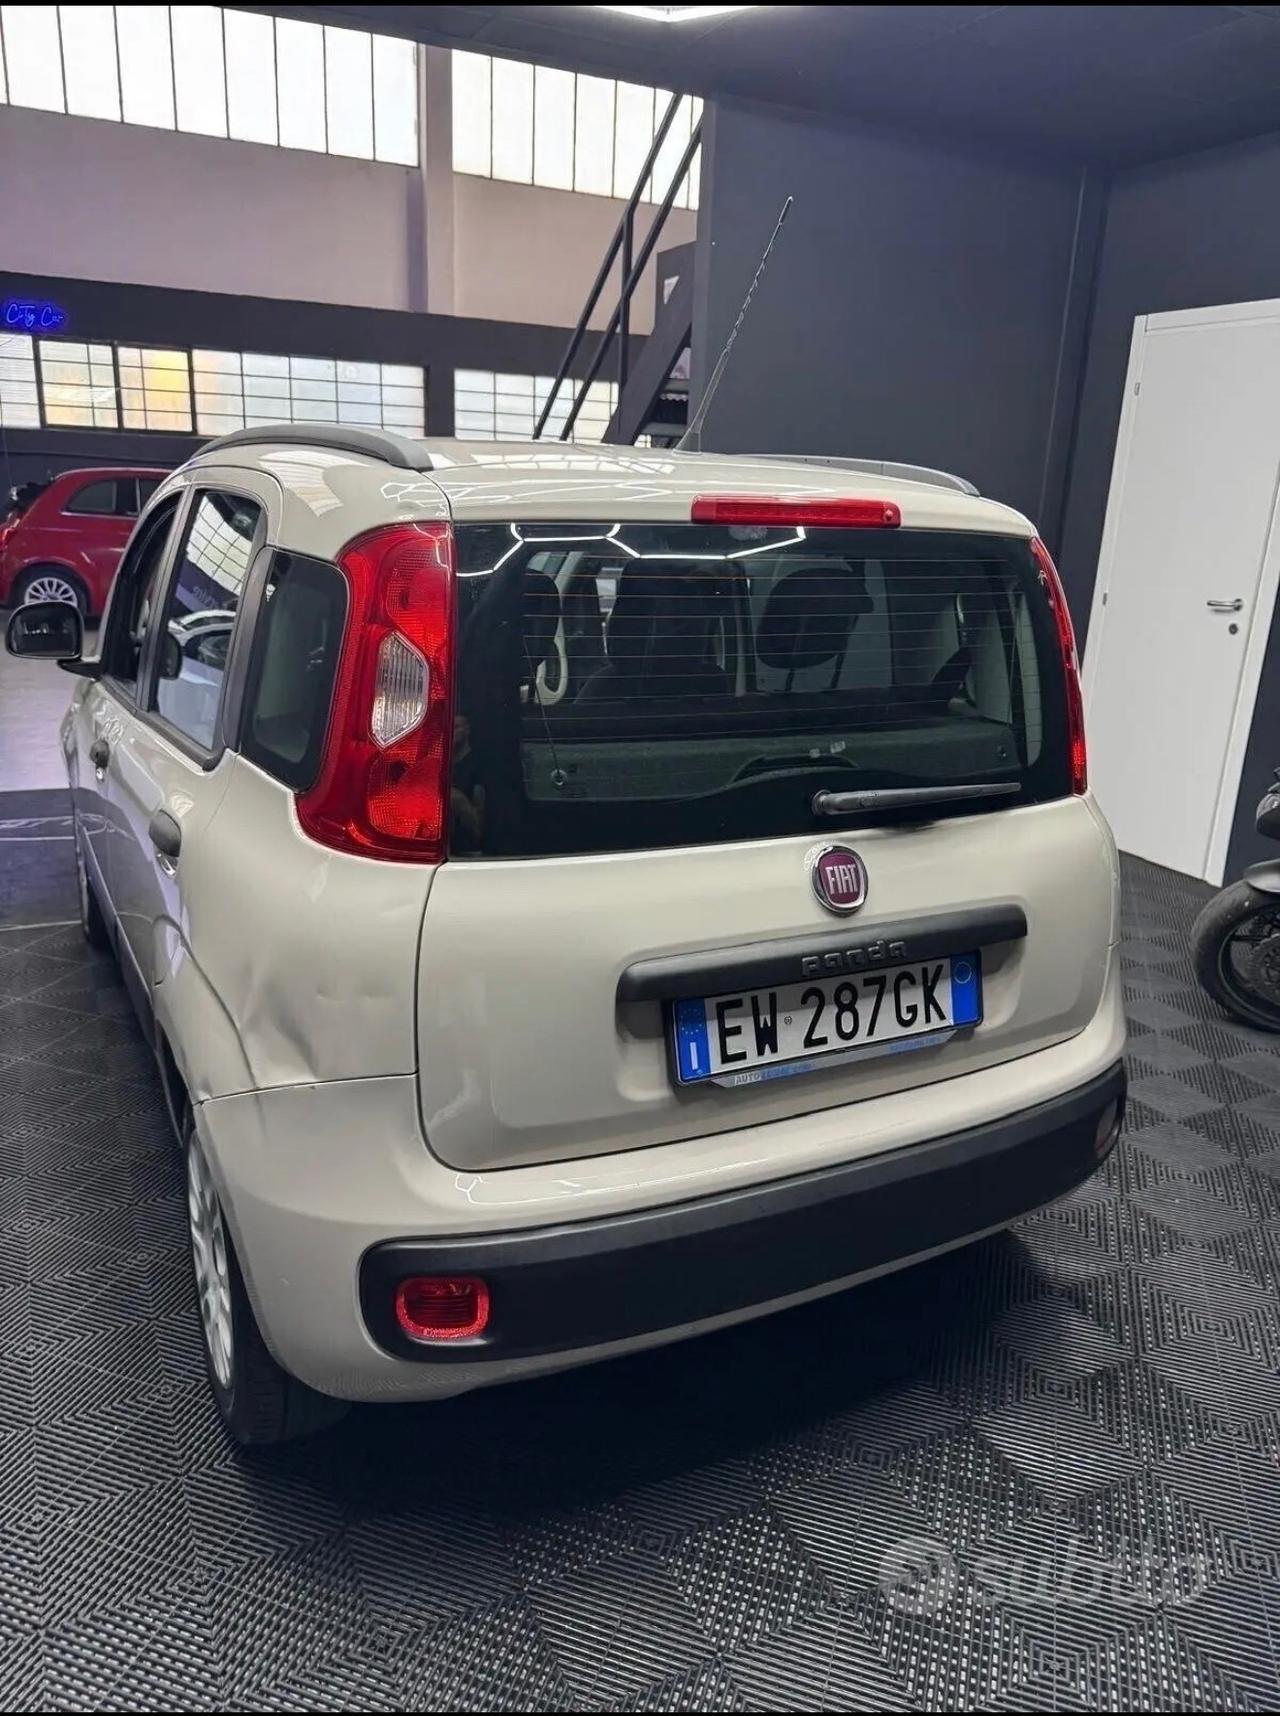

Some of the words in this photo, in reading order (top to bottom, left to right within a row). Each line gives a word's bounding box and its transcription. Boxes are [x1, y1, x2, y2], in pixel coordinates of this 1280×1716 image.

[825, 863, 858, 895] FIAT
[714, 991, 779, 1065] EW
[799, 963, 947, 1049] 287GK
[688, 1041, 699, 1071] I
